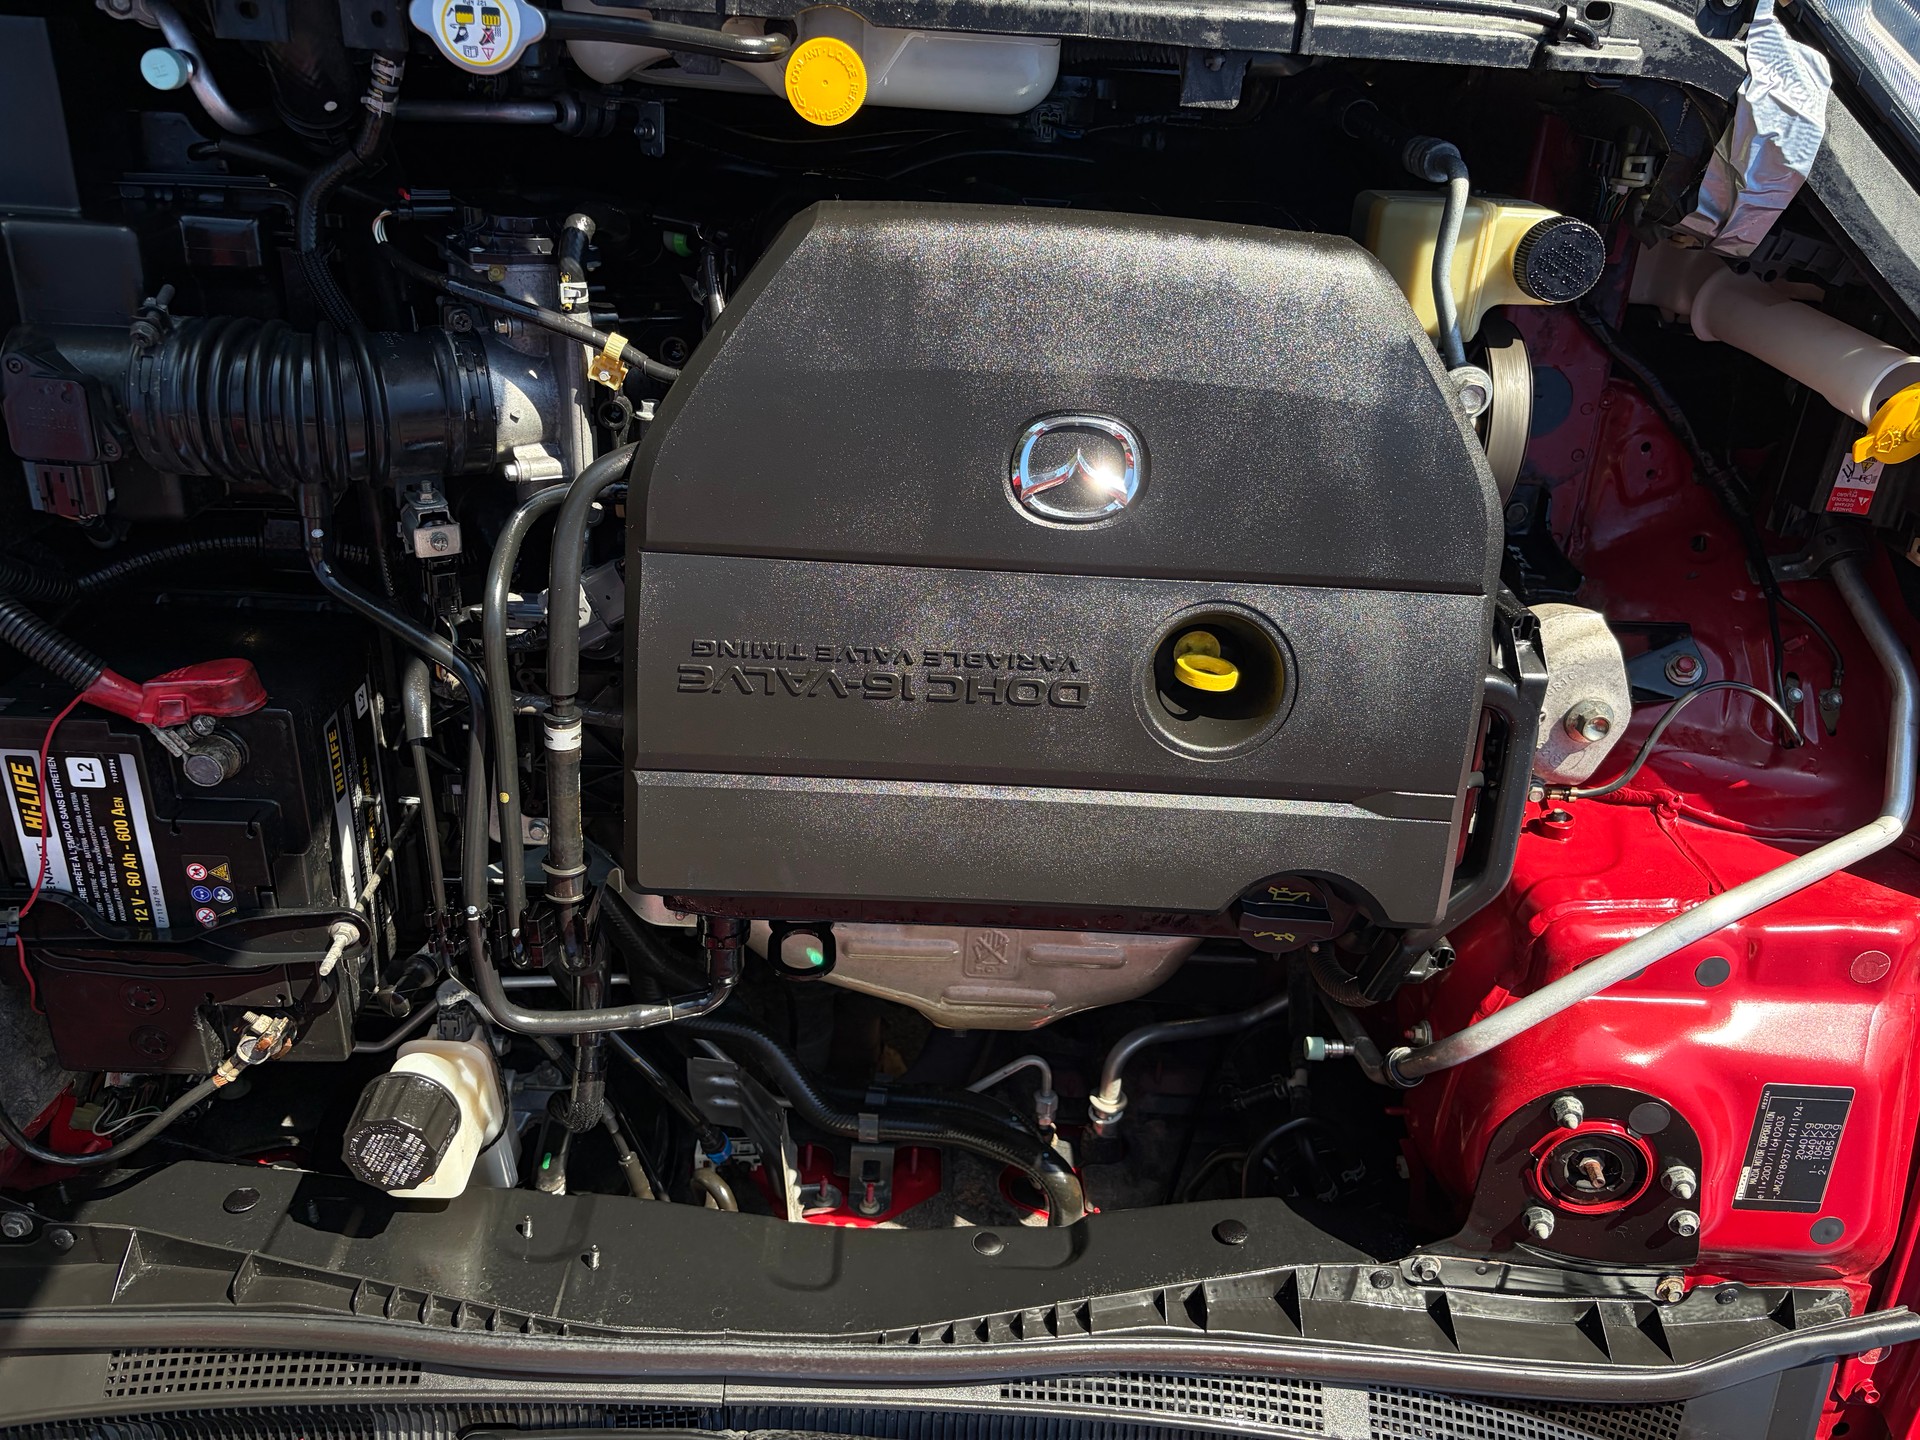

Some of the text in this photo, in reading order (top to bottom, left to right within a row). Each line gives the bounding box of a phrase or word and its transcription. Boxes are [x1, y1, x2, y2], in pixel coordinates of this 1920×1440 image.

[790, 47, 821, 84] COOLANT
[691, 639, 1080, 673] VARIABLE VALVE TIMING
[677, 664, 1090, 709] DOHC 16-VALVE
[357, 690, 365, 709] L2
[76, 761, 96, 783] L2
[108, 758, 119, 782] 7107394
[327, 729, 344, 792] Hi-LIFE
[46, 756, 64, 797] ENTRETIEN
[56, 798, 69, 819] SANS
[61, 820, 78, 854] L'EMPLOI
[112, 817, 132, 841] 600
[35, 842, 57, 890] ENAULT
[120, 852, 138, 868] Ah
[71, 862, 84, 885] PRÊTE
[124, 871, 141, 886] 60
[89, 878, 100, 898] BATTERIE
[131, 897, 145, 905] V
[133, 908, 149, 922] 12
[1749, 1111, 1776, 1185] MAZDA MOTOR CORPORATION
